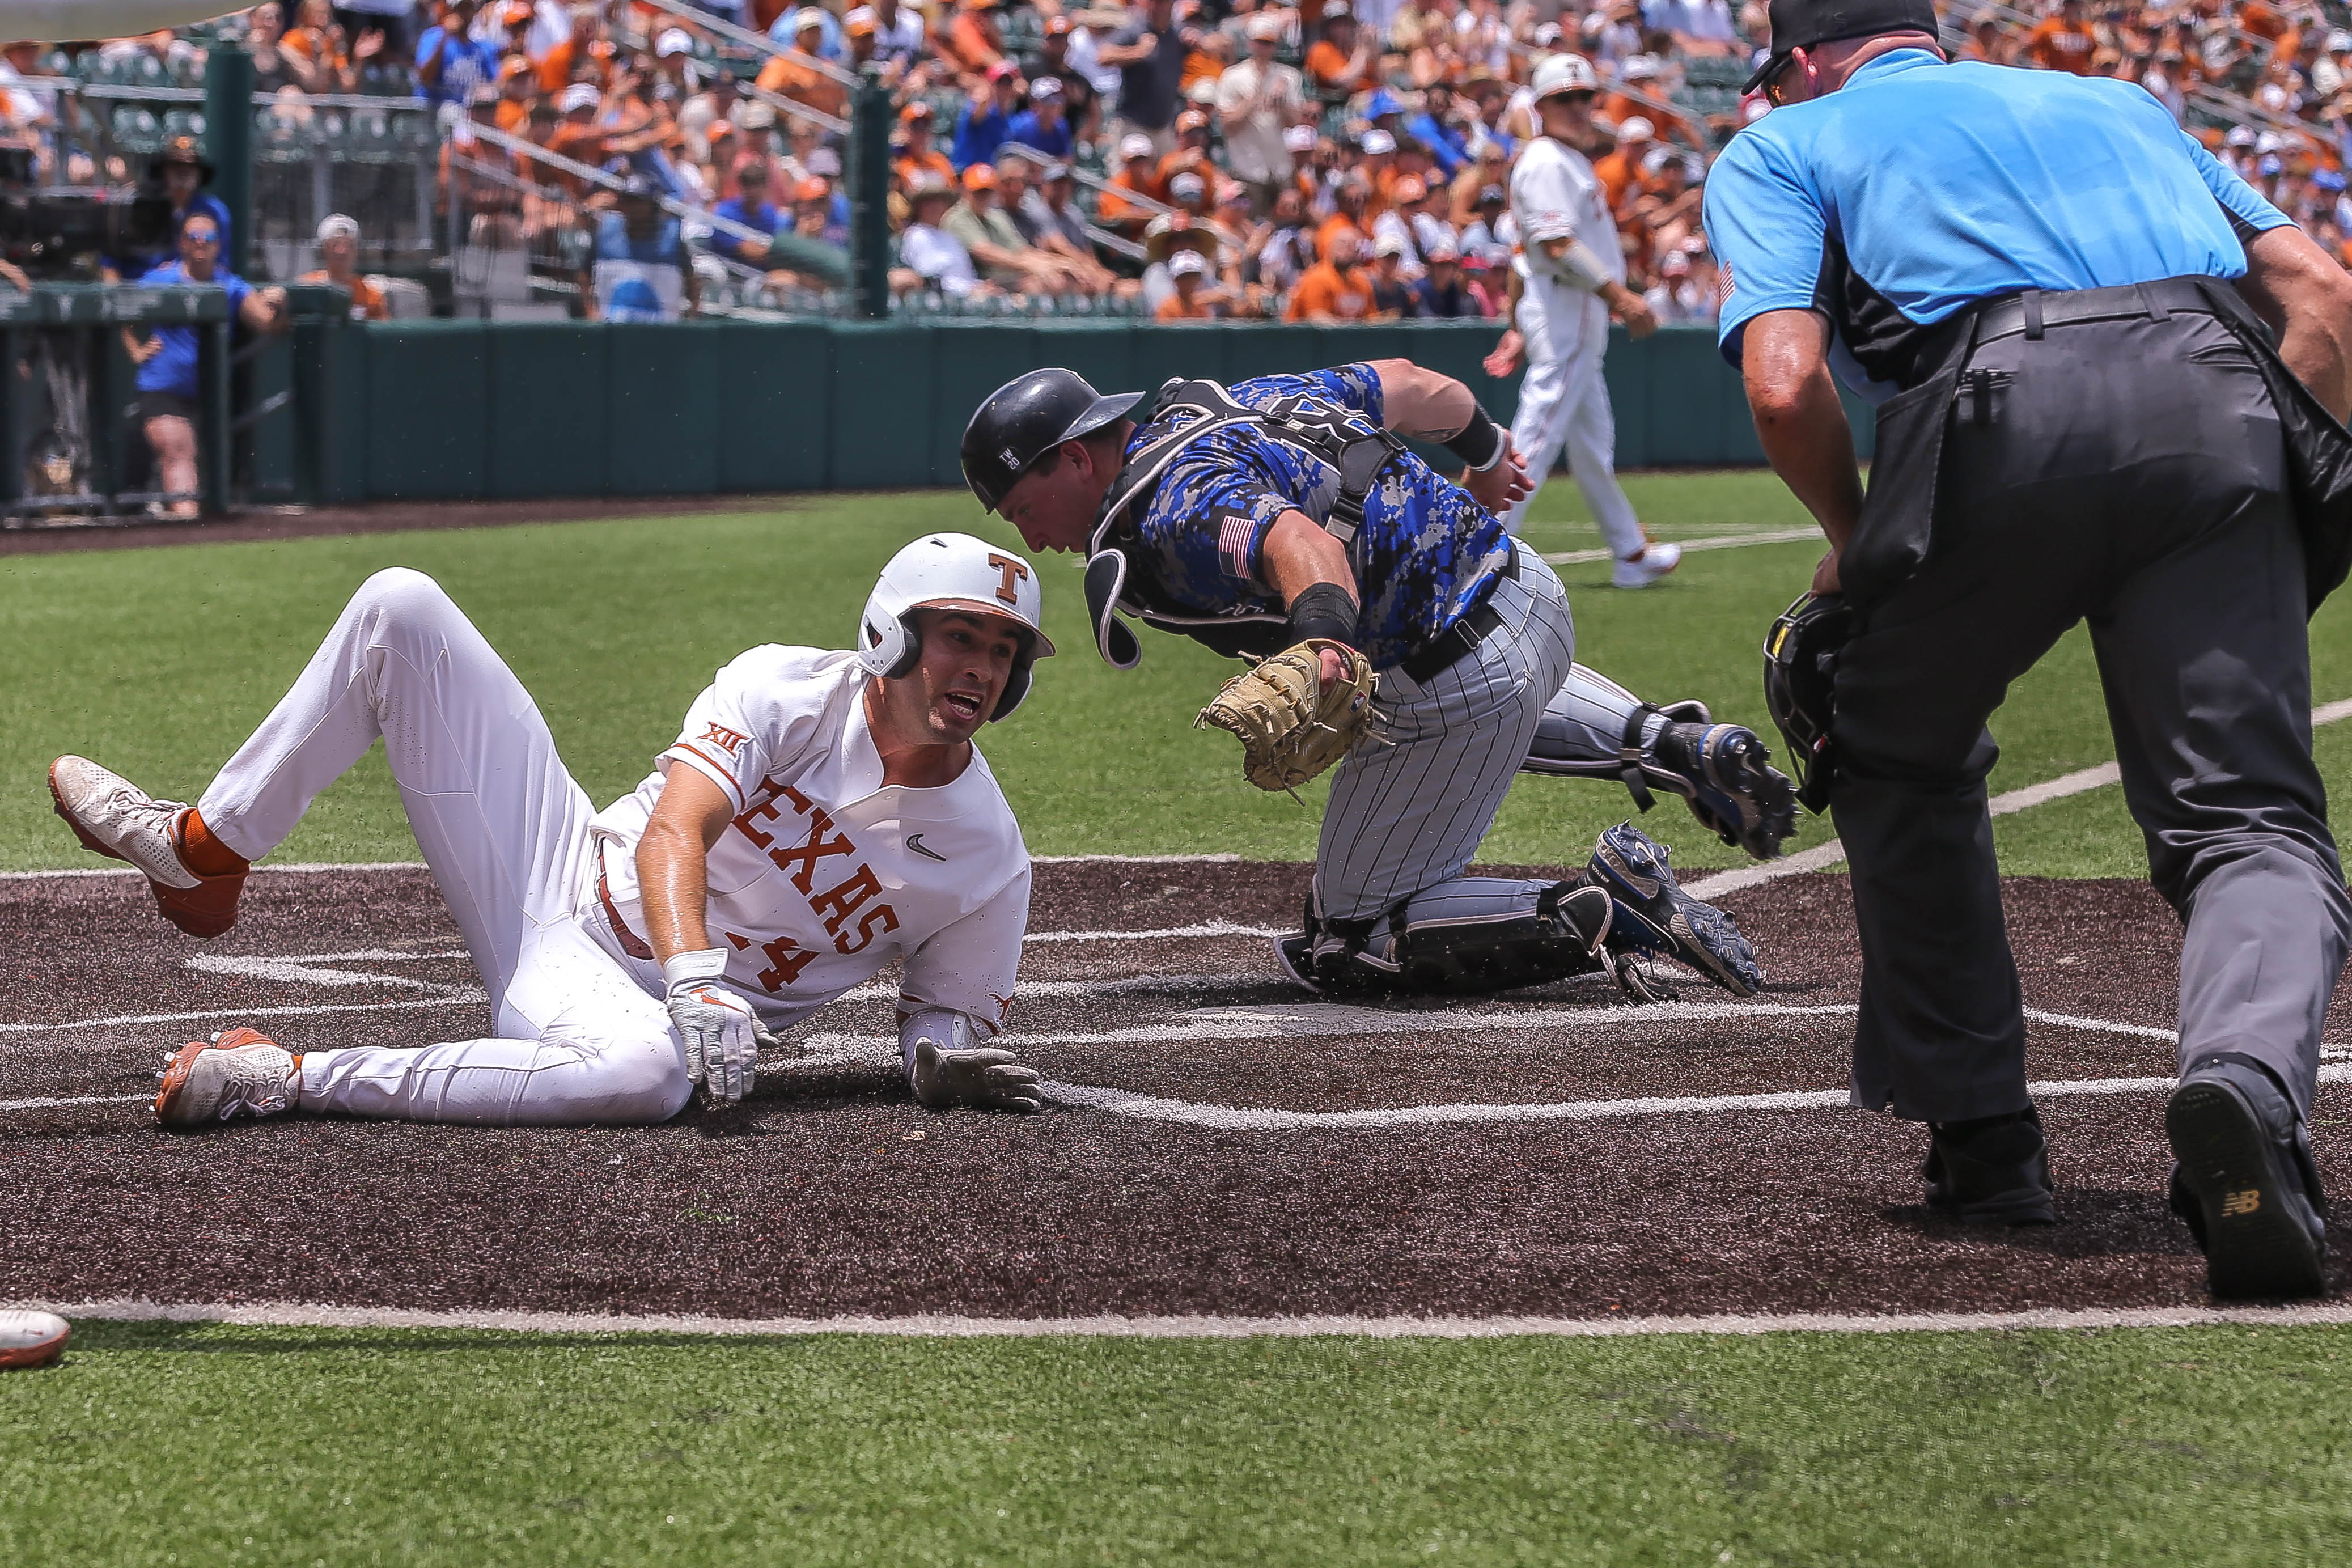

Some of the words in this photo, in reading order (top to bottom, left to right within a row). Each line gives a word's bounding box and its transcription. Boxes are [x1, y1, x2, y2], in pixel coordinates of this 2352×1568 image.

[998, 447, 1014, 463] TW
[1007, 457, 1020, 470] 20
[988, 552, 1028, 606] T
[695, 721, 749, 758] XII
